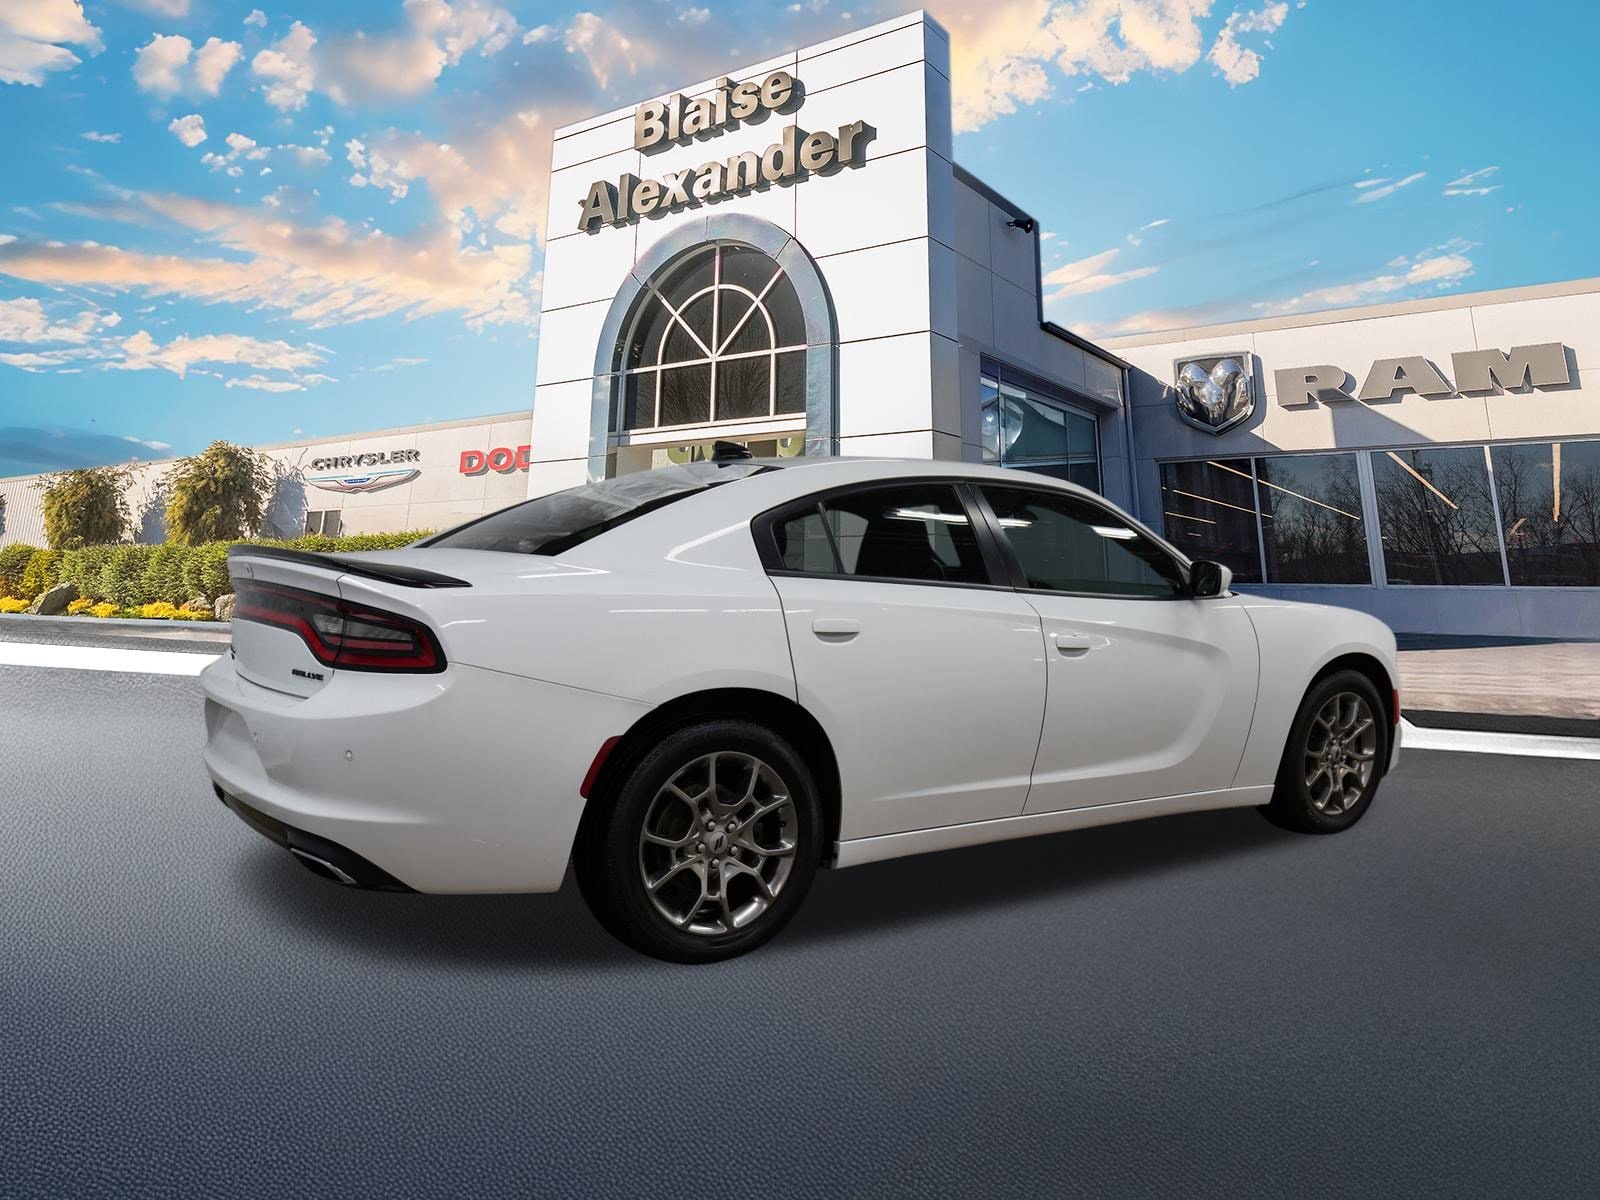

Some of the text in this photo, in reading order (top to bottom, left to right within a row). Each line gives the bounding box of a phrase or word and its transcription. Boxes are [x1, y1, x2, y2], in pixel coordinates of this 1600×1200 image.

[634, 71, 804, 156] Blaise
[577, 120, 876, 234] Alexander
[1274, 342, 1571, 405] RAM
[312, 449, 420, 471] CHRYSLER
